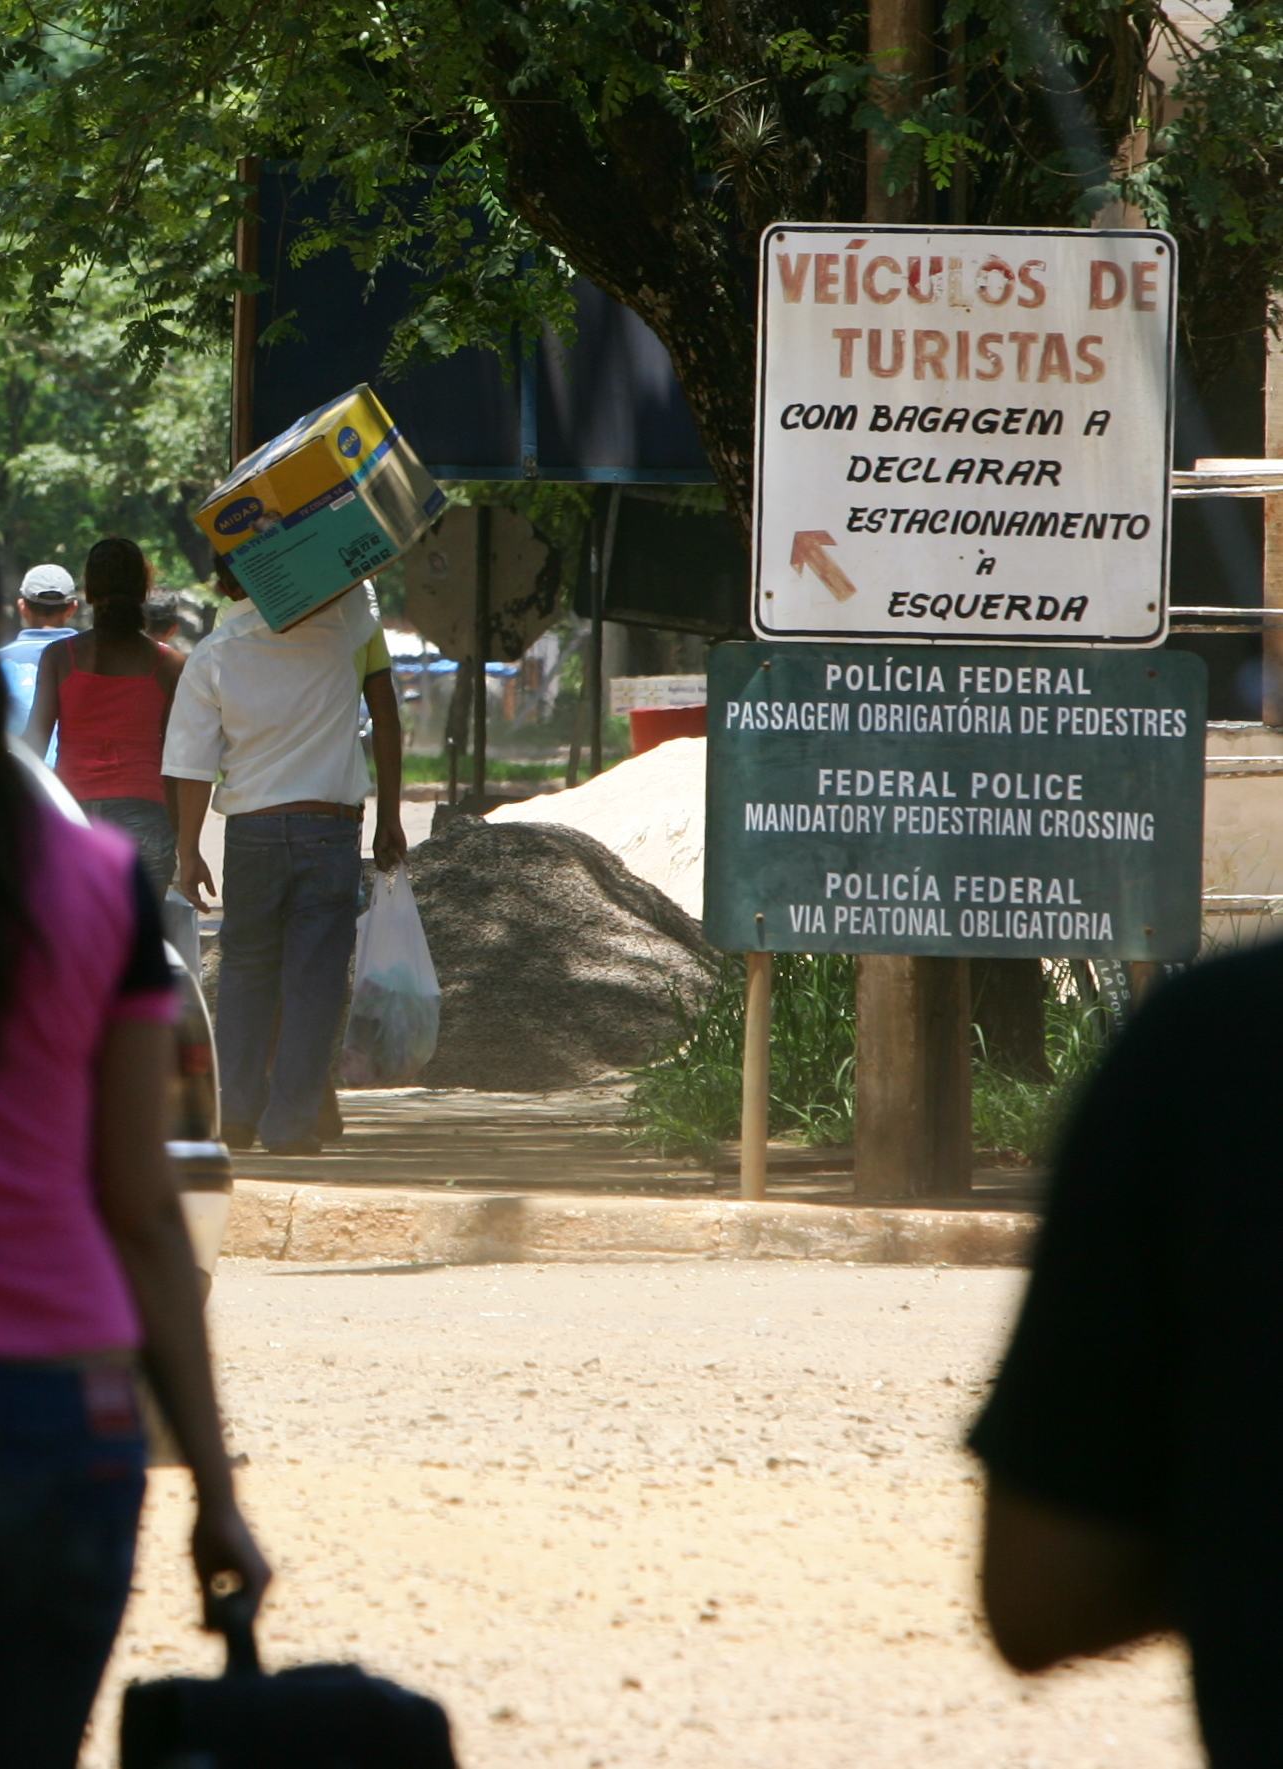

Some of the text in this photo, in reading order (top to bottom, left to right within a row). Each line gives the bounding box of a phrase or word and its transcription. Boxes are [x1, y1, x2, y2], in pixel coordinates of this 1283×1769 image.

[776, 239, 1158, 311] VEÍCULOS DE
[833, 328, 1106, 384] TURISTAS
[781, 403, 1111, 435] COM BAGAGEM A
[847, 456, 1062, 486] DECLARAR
[217, 501, 260, 532] MIDAS
[846, 507, 1150, 540] ESTACIONAMENTO
[976, 549, 996, 575] À
[887, 592, 1089, 621] ESQUERDA
[826, 657, 1092, 696] POLÍCIA FEDERAL
[726, 697, 1187, 738] PASSAGEM OBRIGATÓRIA DE PEDESTRES
[818, 768, 1083, 801] FEDERAL POLICE
[745, 804, 1155, 841] MANDATORY PEDESTRIAN CROSSING
[826, 866, 1082, 906] POLICÍA FEDERAL
[790, 905, 1113, 941] VIA PEATONAL OBLIGATORIA
